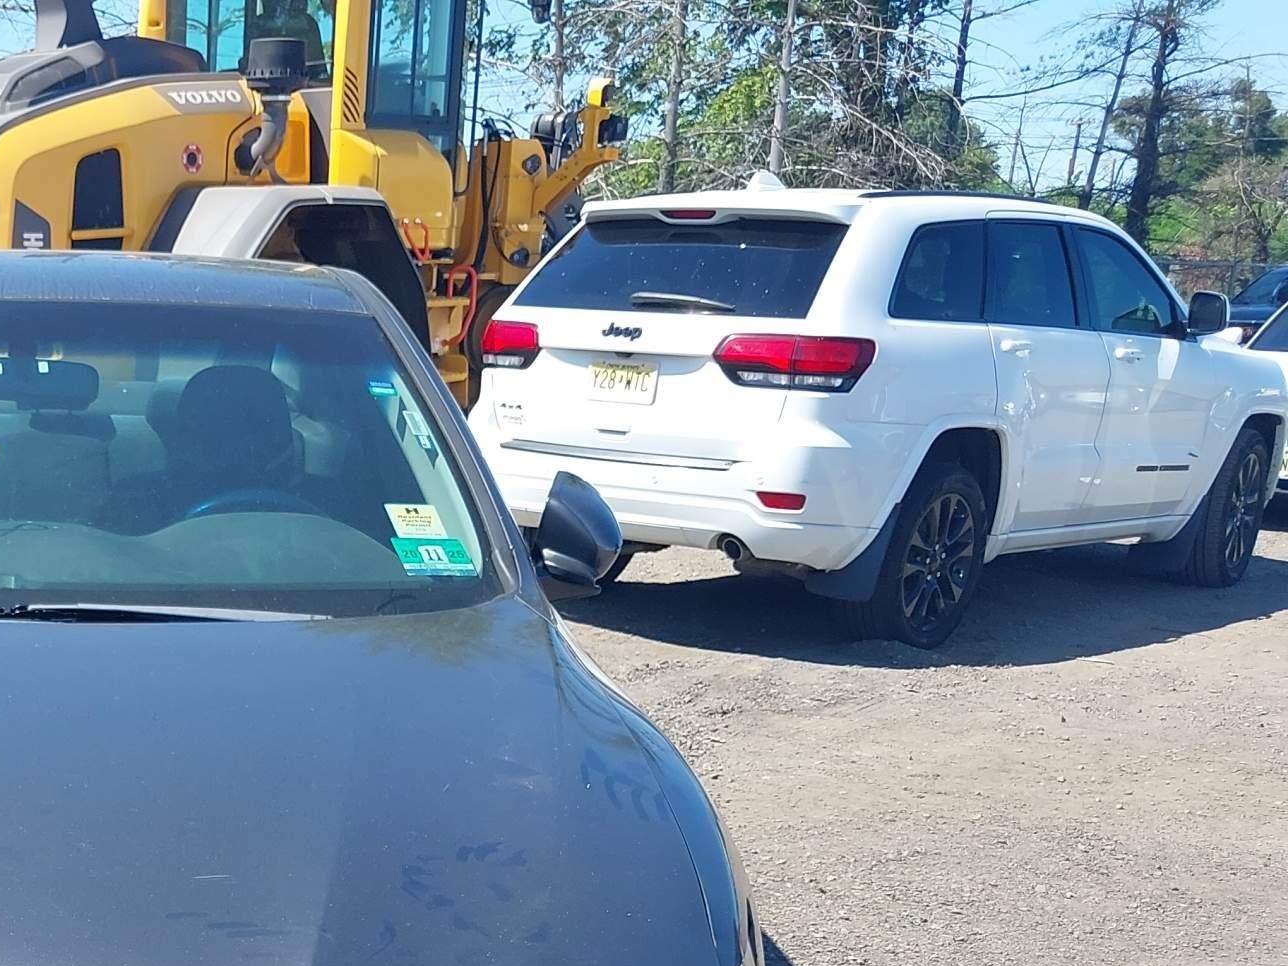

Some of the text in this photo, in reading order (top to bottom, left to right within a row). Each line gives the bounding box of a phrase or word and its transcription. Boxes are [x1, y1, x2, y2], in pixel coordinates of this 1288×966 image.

[168, 89, 242, 105] VOLVO
[22, 233, 44, 250] H
[601, 321, 643, 342] Jeep
[424, 548, 445, 562] 11
